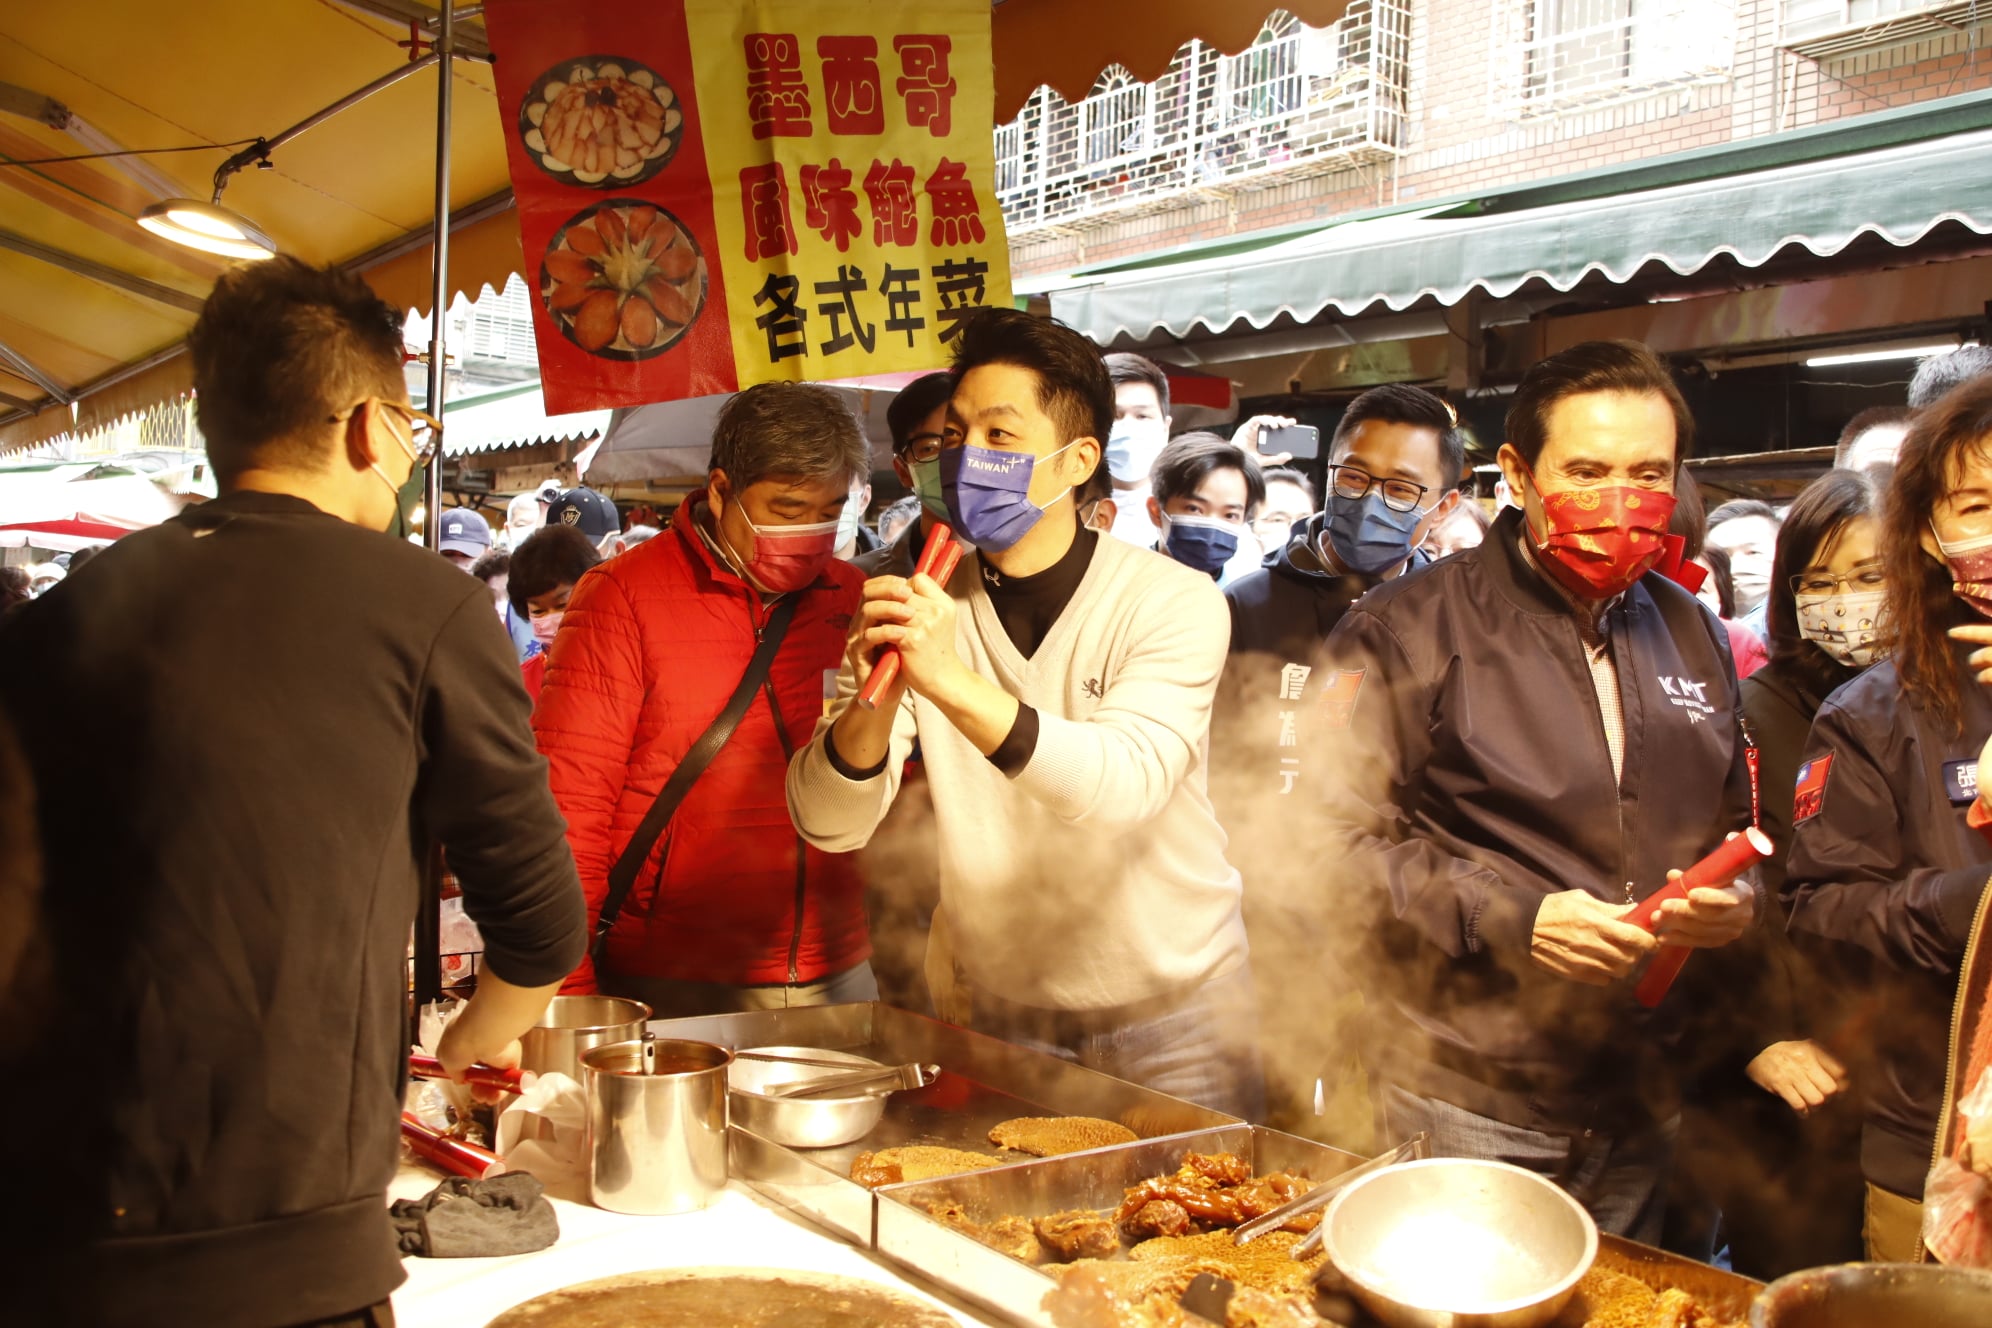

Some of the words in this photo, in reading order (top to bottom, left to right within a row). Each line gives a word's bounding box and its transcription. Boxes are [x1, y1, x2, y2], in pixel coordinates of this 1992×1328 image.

[743, 33, 958, 139] 墨西哥
[738, 157, 986, 263] 風味鮑魚
[753, 257, 992, 363] 各式年菜
[967, 458, 1009, 474] TAIWAN
[1657, 676, 1707, 702] KMT
